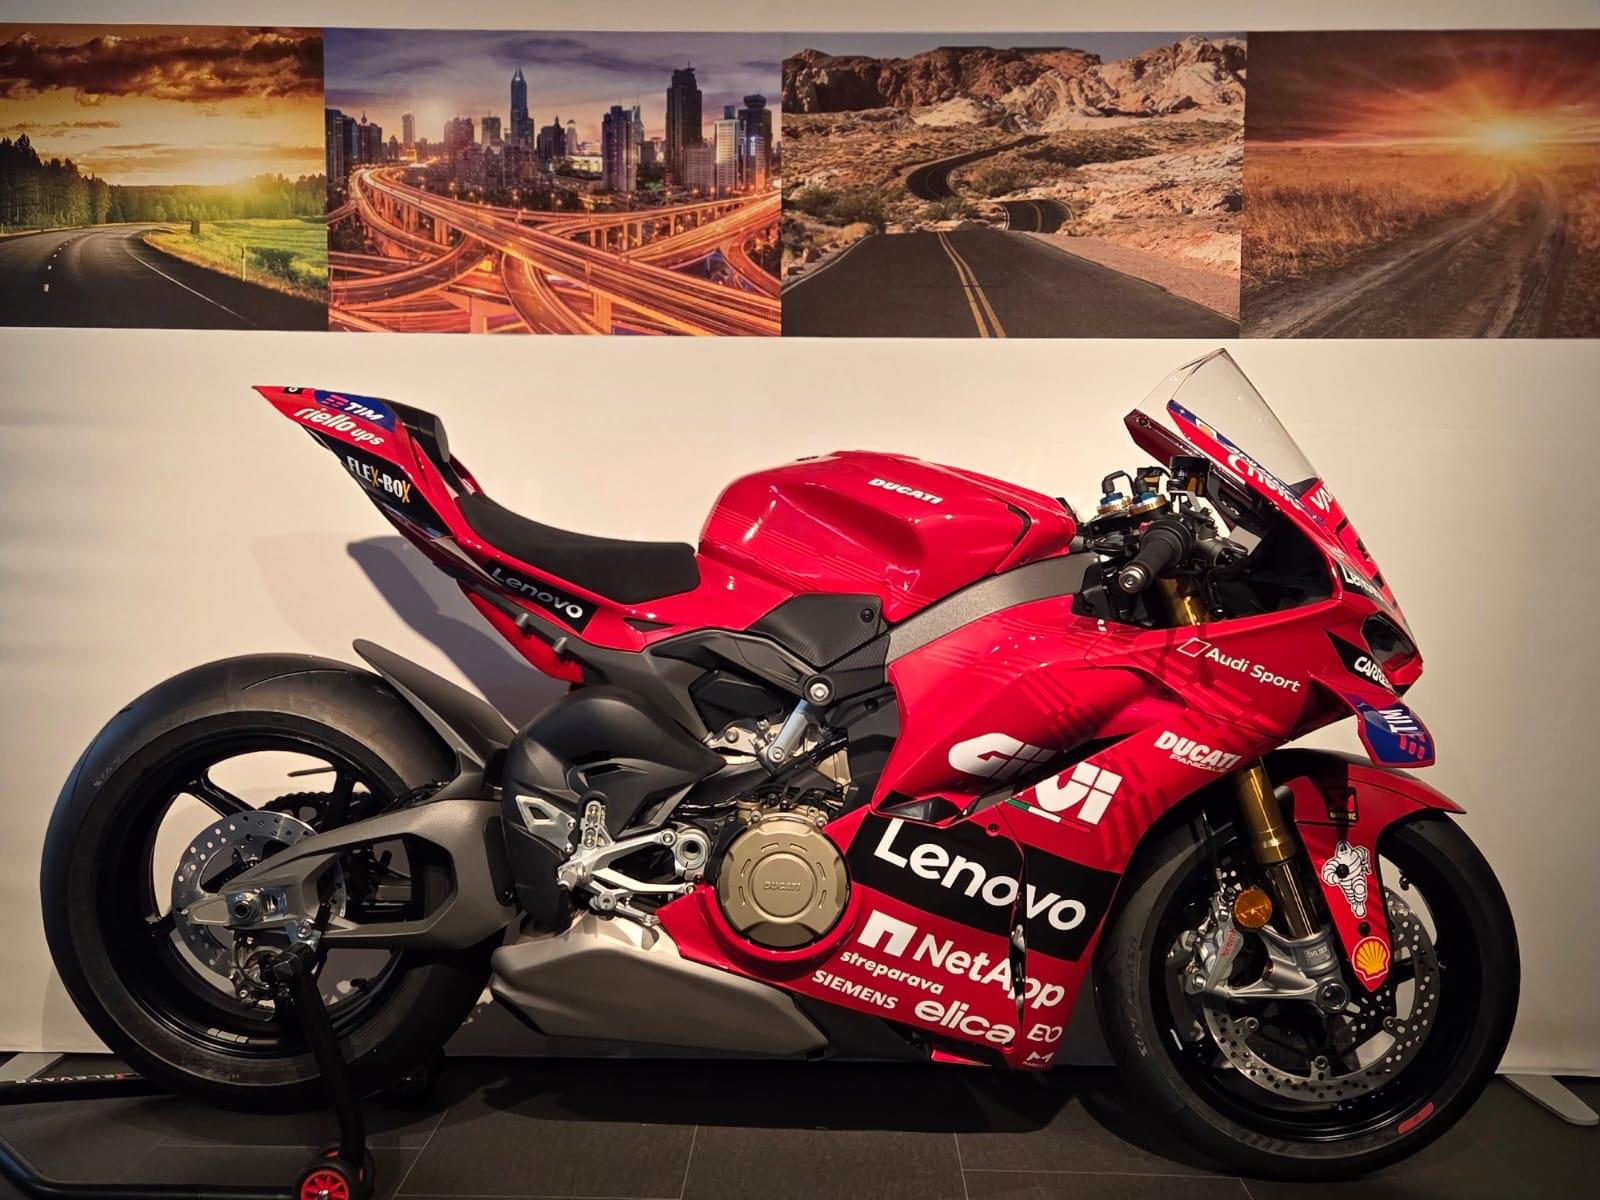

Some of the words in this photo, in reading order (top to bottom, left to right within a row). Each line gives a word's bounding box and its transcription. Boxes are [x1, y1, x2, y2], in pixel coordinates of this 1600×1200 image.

[293, 408, 357, 432] riello
[350, 428, 385, 445] ups
[344, 402, 385, 420] TIM
[347, 455, 411, 503] FLEX-BOX
[867, 477, 943, 504] DUCATI
[491, 566, 584, 619] Lenovo
[1205, 647, 1250, 673] Audi
[1250, 664, 1301, 693] Sport
[1153, 730, 1242, 769] DUCATI
[763, 881, 802, 892] DUCATI
[873, 818, 1087, 931] Lenovo
[812, 969, 899, 1010] SIEMENS
[840, 949, 945, 996] streparava
[913, 933, 1065, 1009] NetApp
[914, 999, 1016, 1045] elica
